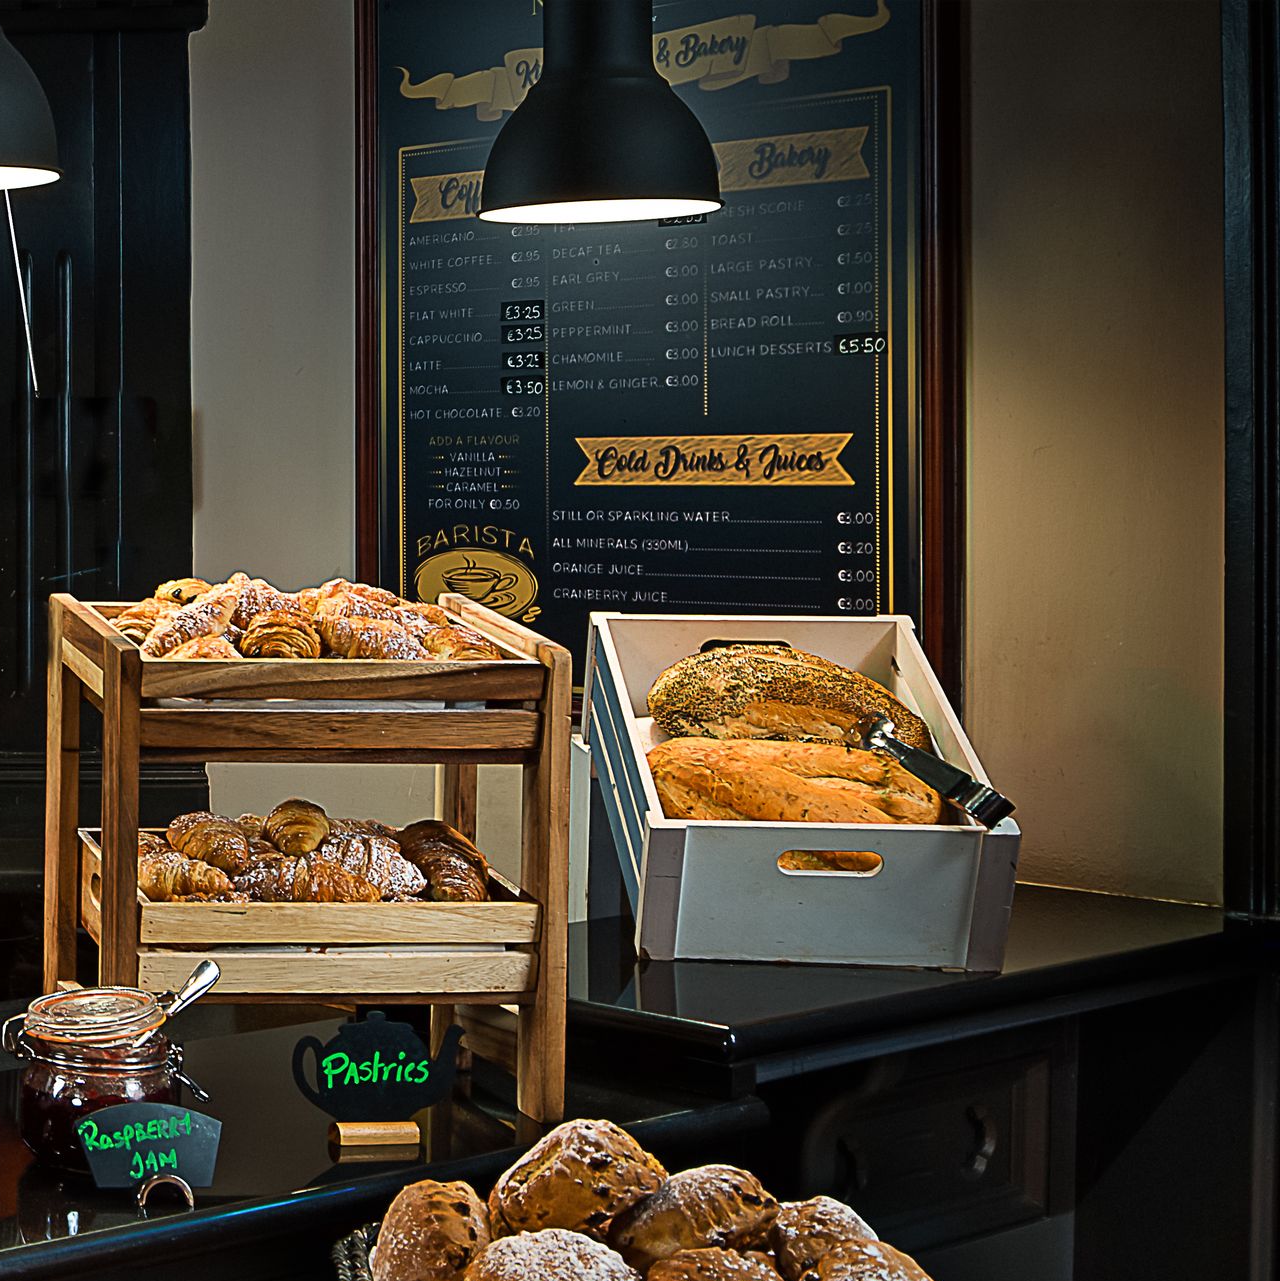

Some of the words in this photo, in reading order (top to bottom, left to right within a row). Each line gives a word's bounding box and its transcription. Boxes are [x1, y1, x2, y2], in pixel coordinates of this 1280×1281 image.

[675, 33, 749, 69] Bakery
[748, 141, 832, 180] Bakery
[759, 200, 806, 214] SCONE
[409, 230, 475, 246] AMERICANO
[511, 224, 540, 237] €2.95
[712, 232, 754, 246] TOAST
[552, 246, 593, 259] DECAF
[599, 243, 622, 256] TEA
[409, 259, 443, 271] WHITE
[447, 254, 494, 268] COFFEE
[511, 250, 540, 263] €2.95
[711, 260, 754, 275] LARGE
[759, 256, 813, 271] PASTRY
[837, 251, 873, 265] €1.50
[552, 274, 582, 286] EARL
[586, 271, 620, 284] GREY
[665, 264, 698, 278] €3.00
[409, 282, 467, 296] ESPRESSO
[511, 276, 540, 289] €2.95
[711, 290, 752, 303] SMALL
[756, 286, 811, 300] PASTRY
[837, 281, 873, 295] €1.00
[552, 300, 595, 313] GREEN
[665, 293, 698, 306] €3.00
[409, 310, 435, 321] FLAT
[440, 307, 475, 319] WHITE
[711, 316, 757, 330] BREAD
[761, 315, 793, 328] ROLL
[837, 310, 874, 324] €0.90
[552, 323, 632, 339] PEPPERMINT
[665, 320, 699, 333] €3.00
[409, 332, 483, 346] CAPPUCCINO
[552, 351, 623, 364] CHAMOMILE
[665, 347, 699, 360] €3.00
[711, 345, 756, 359] LUNCH
[760, 341, 833, 356] DESSERTS
[409, 360, 442, 371] LATTE
[409, 384, 449, 395] MOCHA
[552, 379, 594, 391] LEMON
[597, 378, 605, 389] &
[609, 376, 658, 389] GINGER
[665, 374, 699, 387] €3.00
[410, 410, 431, 420] HOT
[435, 407, 502, 419] CHOCOLATE
[511, 406, 541, 418] €3.20
[429, 436, 453, 447] ADD
[456, 436, 463, 446] A
[467, 434, 520, 446] FLAVOUR
[450, 452, 495, 462] VANILLA
[595, 445, 650, 480] Cold
[654, 444, 728, 481] Drinks
[734, 443, 751, 478] &
[758, 443, 829, 480] Juices
[444, 466, 501, 477] HAZELNUT
[446, 482, 499, 492] CARAMEL
[428, 499, 452, 509] FOR
[454, 498, 486, 509] ONLY
[489, 498, 520, 510] €0.50
[552, 509, 583, 522] STILL
[586, 509, 605, 522] OR
[608, 509, 679, 523] SPARKLING
[683, 511, 731, 524] WATER
[837, 512, 874, 525] €3.00
[417, 523, 535, 561] BARISTA
[552, 537, 572, 548] ALL
[576, 538, 638, 550] MINERALS
[641, 538, 689, 552] (330ML)
[837, 541, 874, 554] €3.20
[552, 562, 604, 575] ORANGE
[608, 563, 644, 576] JUICE
[837, 570, 874, 583] €3.00
[553, 588, 627, 602] CRANBERRY
[631, 589, 669, 603] JUICE
[837, 598, 874, 611] €3.00
[130, 1149, 178, 1179] JAM
